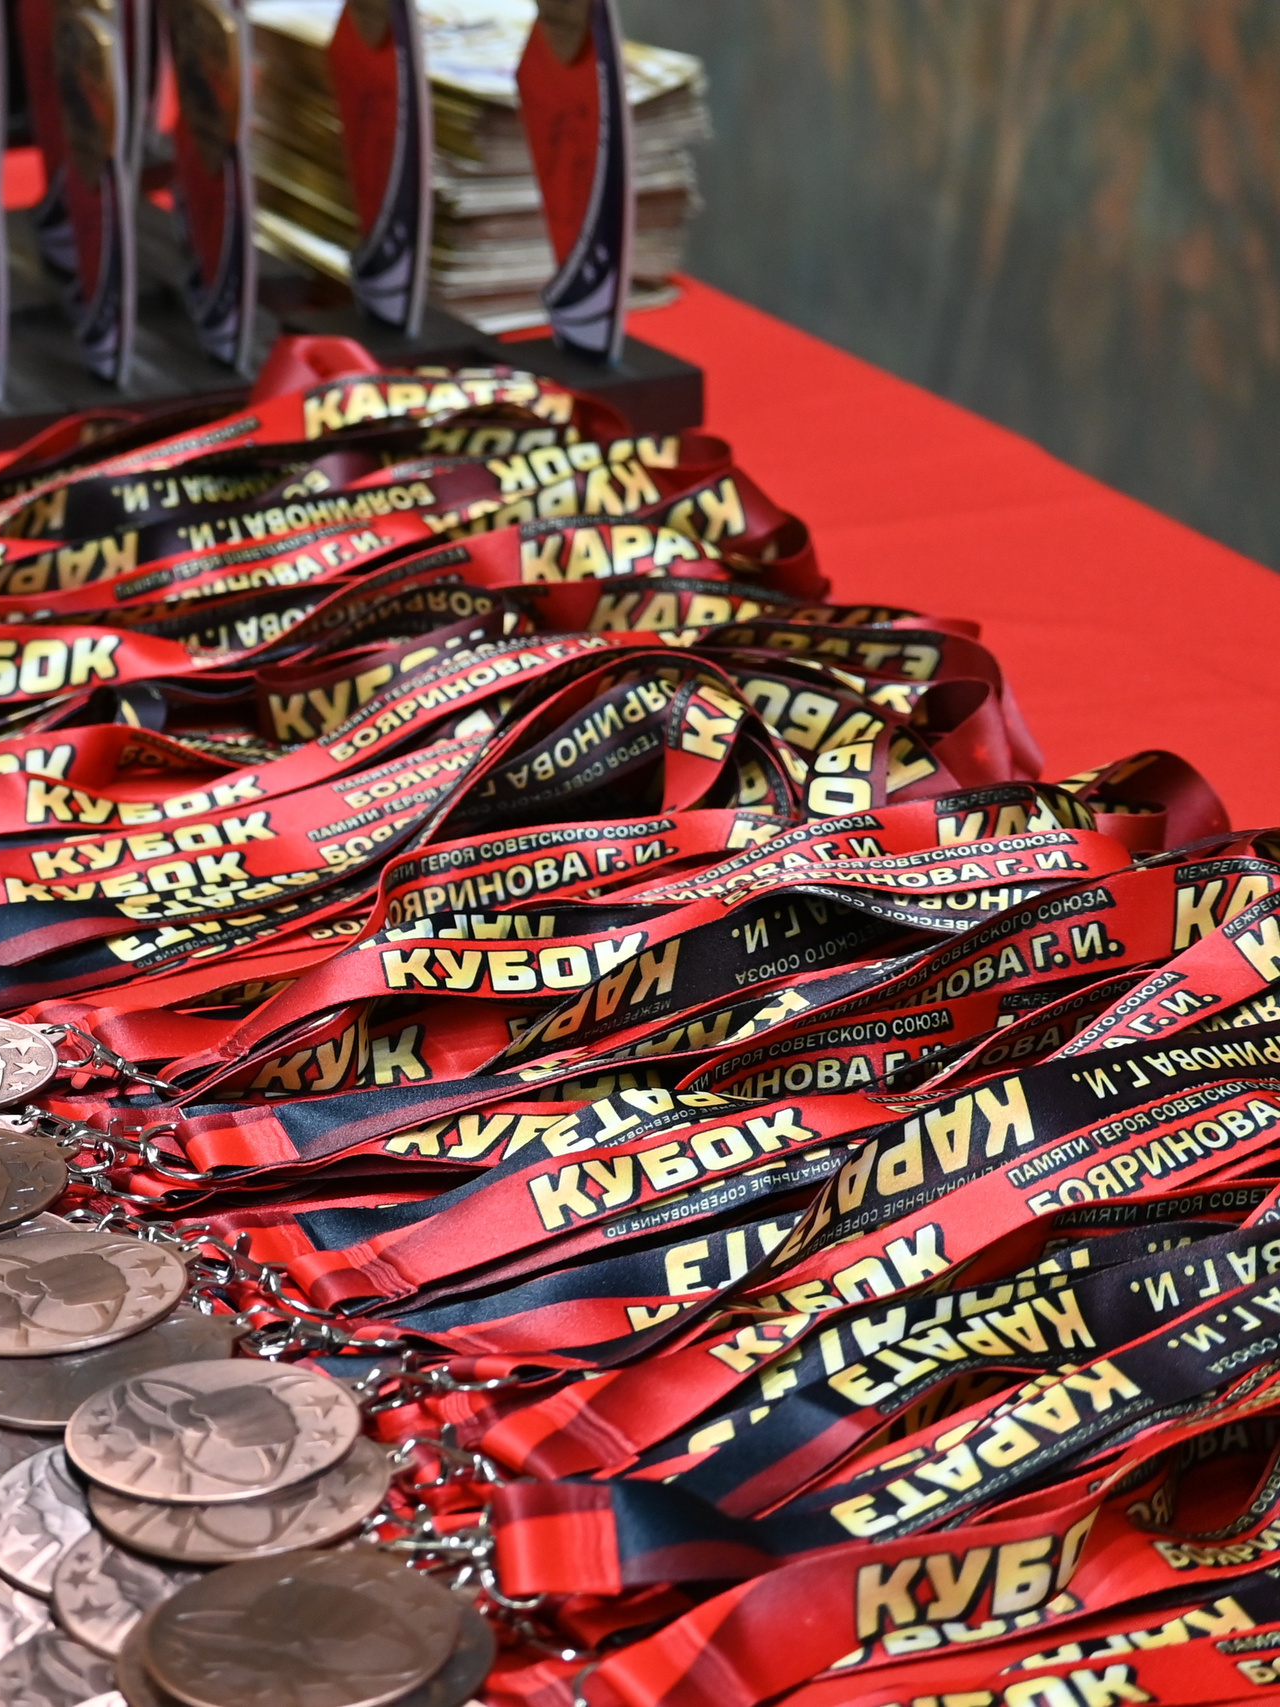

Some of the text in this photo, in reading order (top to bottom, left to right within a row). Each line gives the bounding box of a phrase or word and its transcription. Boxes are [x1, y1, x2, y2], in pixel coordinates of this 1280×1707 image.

[242, 482, 436, 541] БОЯРИНОВА
[522, 523, 723, 583] КАРА
[328, 651, 546, 762] БОЯРИНОВА
[506, 680, 677, 791] ОЯРИНОВА
[25, 774, 265, 825] КУБОК
[31, 810, 277, 880] КУБОК
[421, 851, 476, 879] ГЕРОЯ
[480, 826, 599, 858] СОВЕТСКОГО
[603, 818, 676, 838] СОЮЗА
[695, 831, 807, 886] СОВЕТСКОГО
[808, 814, 878, 837] СОЮЗА
[870, 840, 994, 869] СОВЕТСКОГО
[996, 831, 1073, 851] СОЮЗА
[1176, 858, 1280, 880] МЕЖРЕГИОНА
[5, 851, 251, 903] КУБОК
[387, 851, 590, 921] ОЯРИНОВА
[722, 862, 989, 906] БОЯРИНОВА
[382, 932, 644, 991] КУБОК
[735, 953, 801, 986] СОЮЗА
[877, 971, 928, 998] ГЕРОЯ
[930, 911, 1031, 972] СОВЕТСКОГО
[1038, 888, 1109, 921] СОЮЗА
[1071, 923, 1118, 959] И.
[714, 1010, 950, 1080] ГЕРОЯ СОВЕТСКОГО СОЮЗА
[1053, 1015, 1117, 1061] ТСКОГО
[1116, 972, 1180, 1015] СОЮЗА
[1143, 1033, 1280, 1078] РИНОВА
[604, 1108, 696, 1147] СОРЕВНОВАН
[1007, 1079, 1258, 1187] ПАМЯТИ ГЕРОЯ СОВЕТСКОГО
[530, 1107, 816, 1231] КУБОК
[1028, 1100, 1280, 1217] БОЯРИНОВА
[606, 1156, 842, 1238] ИОНАЛЬНЫЕ СОРЕВНОВАНИЯ ПО
[1146, 1198, 1203, 1220] ГЕРОЯ
[1209, 1188, 1272, 1209] СОВЕТ
[1130, 1271, 1180, 1312] И.
[828, 1288, 1096, 1406] КАРАТЭ
[831, 1359, 1142, 1537] КАРАТЭ
